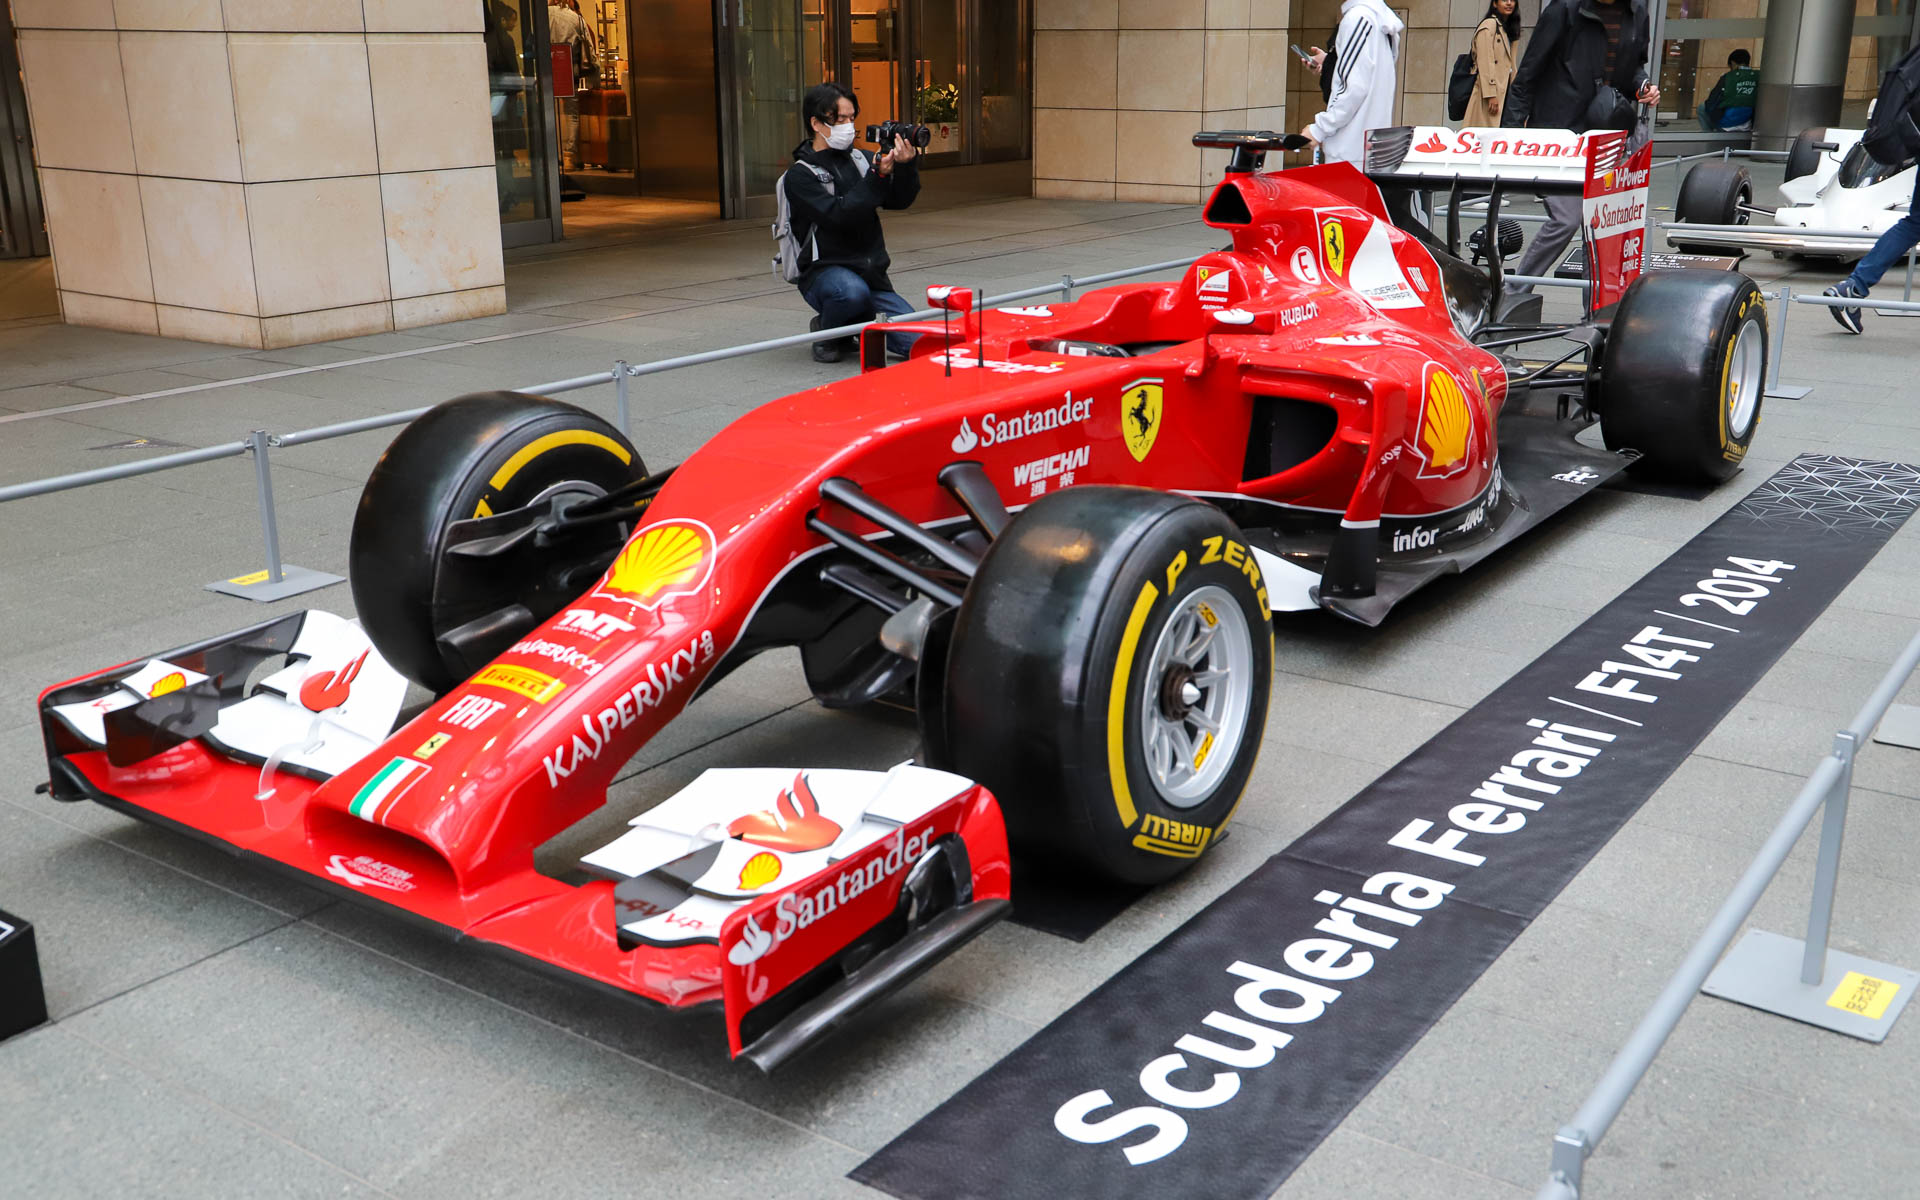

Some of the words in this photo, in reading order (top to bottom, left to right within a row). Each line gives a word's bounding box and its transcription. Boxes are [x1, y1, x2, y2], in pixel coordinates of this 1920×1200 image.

[1615, 167, 1649, 189] V-Power
[1600, 196, 1645, 229] Santander
[1298, 251, 1316, 281] E
[1280, 302, 1319, 326] HUBLOT
[981, 390, 1094, 447] Santander
[1013, 445, 1091, 487] WEICHAI
[1393, 526, 1440, 552] infor
[1167, 549, 1188, 596] P
[1199, 535, 1272, 622] ZERO
[557, 609, 636, 638] TNT
[482, 668, 548, 697] PIRELLI
[438, 694, 507, 730] FIAT
[542, 637, 698, 789] KASPERSKY
[1132, 813, 1213, 859] PIRELLI
[1054, 871, 1456, 1165] Scuderia
[1387, 718, 1617, 867] Ferrari
[1574, 625, 1715, 704] F14T
[1679, 556, 1797, 616] 2014
[776, 825, 935, 942] Santander
